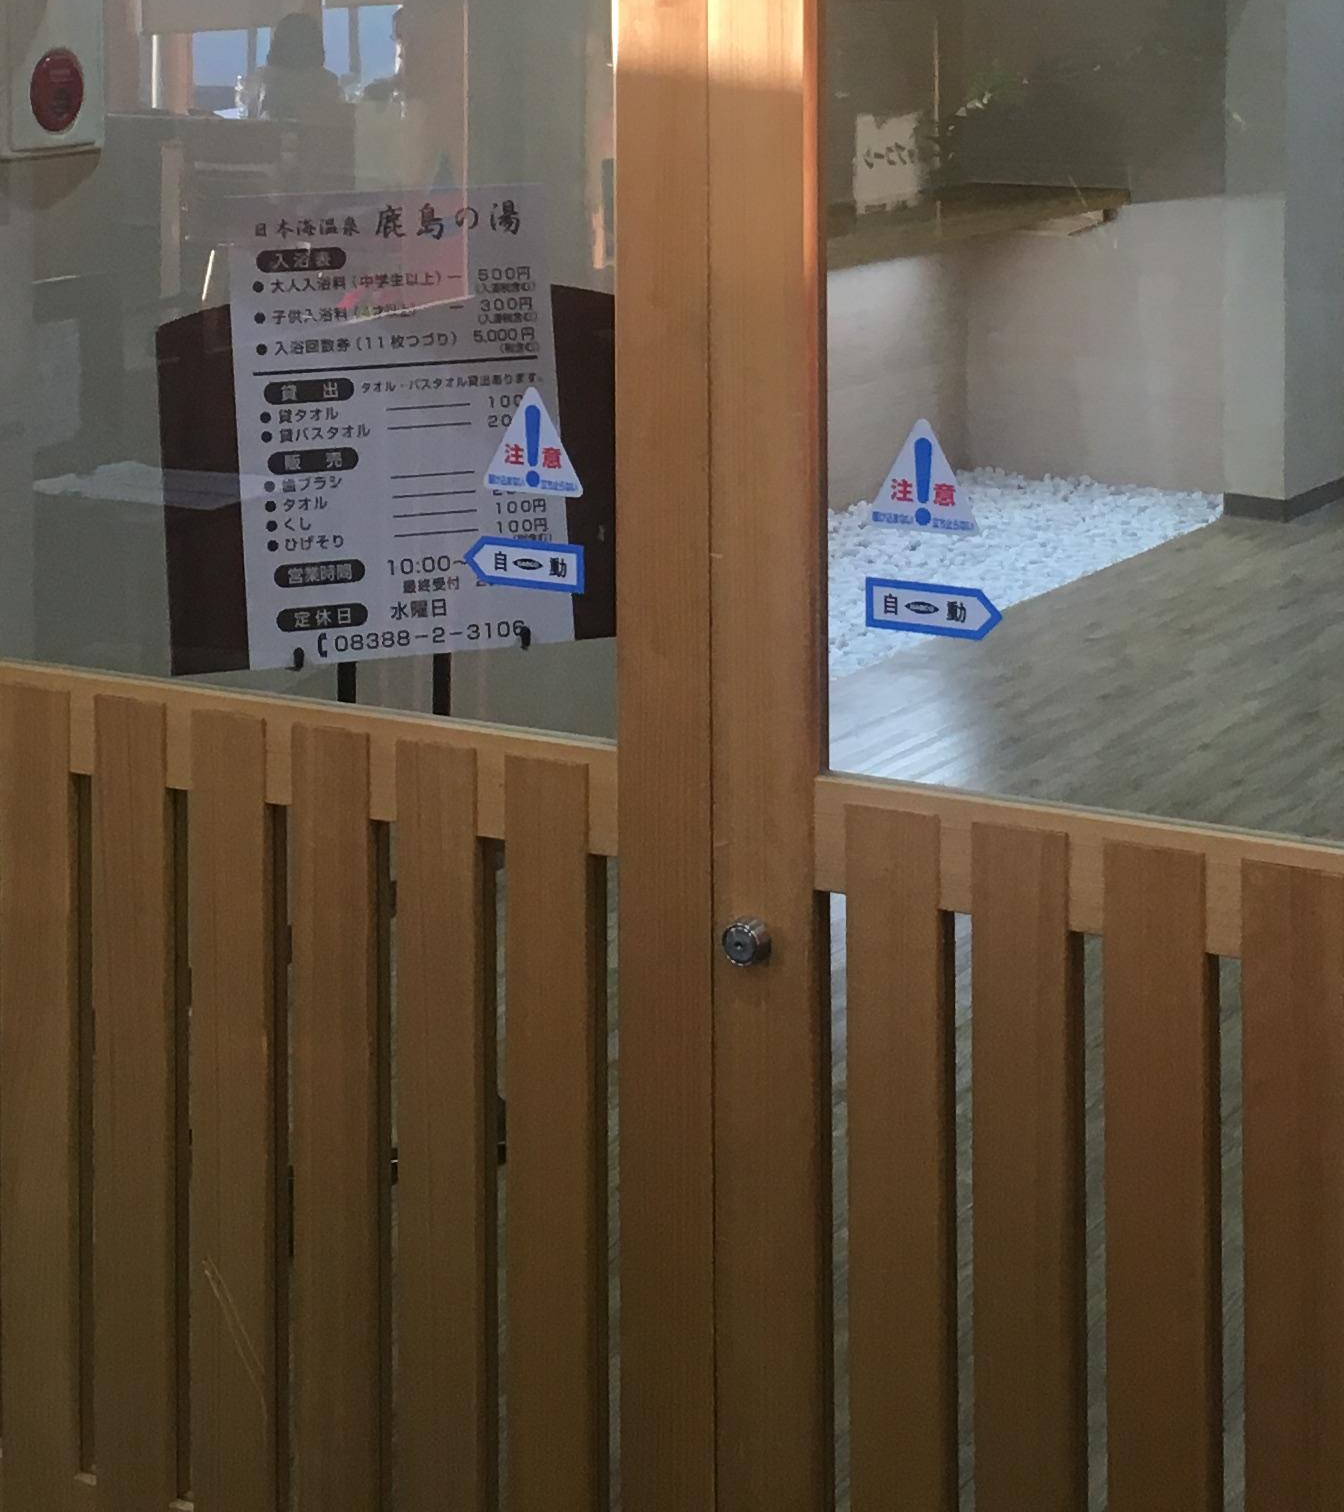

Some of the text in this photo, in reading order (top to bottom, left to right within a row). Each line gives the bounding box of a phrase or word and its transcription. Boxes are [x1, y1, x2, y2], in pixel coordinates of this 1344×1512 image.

[255, 199, 521, 240] 日本海温泉 鹿島の湯
[478, 266, 530, 281] 500円
[480, 297, 532, 312] 300円
[278, 407, 339, 424] 貸タオル
[279, 424, 371, 444] 貸バスタオル
[283, 496, 546, 514] タオル 100円
[284, 517, 548, 533] くし 100円
[285, 535, 344, 551] ひげそり
[287, 563, 353, 585] 営業時間
[403, 576, 460, 594] 最終受付
[294, 599, 448, 628] 定休日 水曜日
